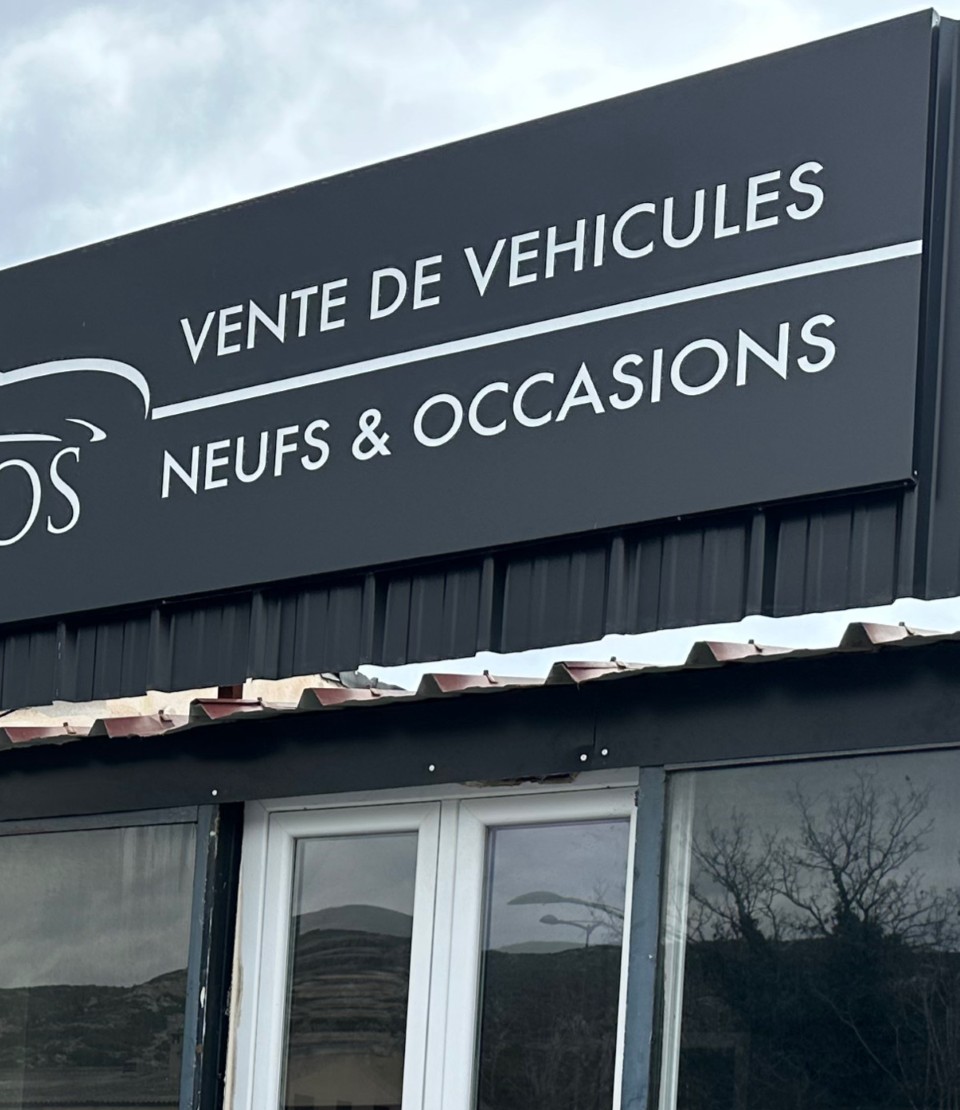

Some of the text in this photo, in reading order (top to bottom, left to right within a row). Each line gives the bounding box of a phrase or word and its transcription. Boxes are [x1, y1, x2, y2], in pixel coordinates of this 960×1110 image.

[180, 161, 824, 365] VENTE DE VEHICULES
[161, 313, 836, 499] NEUFS & OCCASIONS
